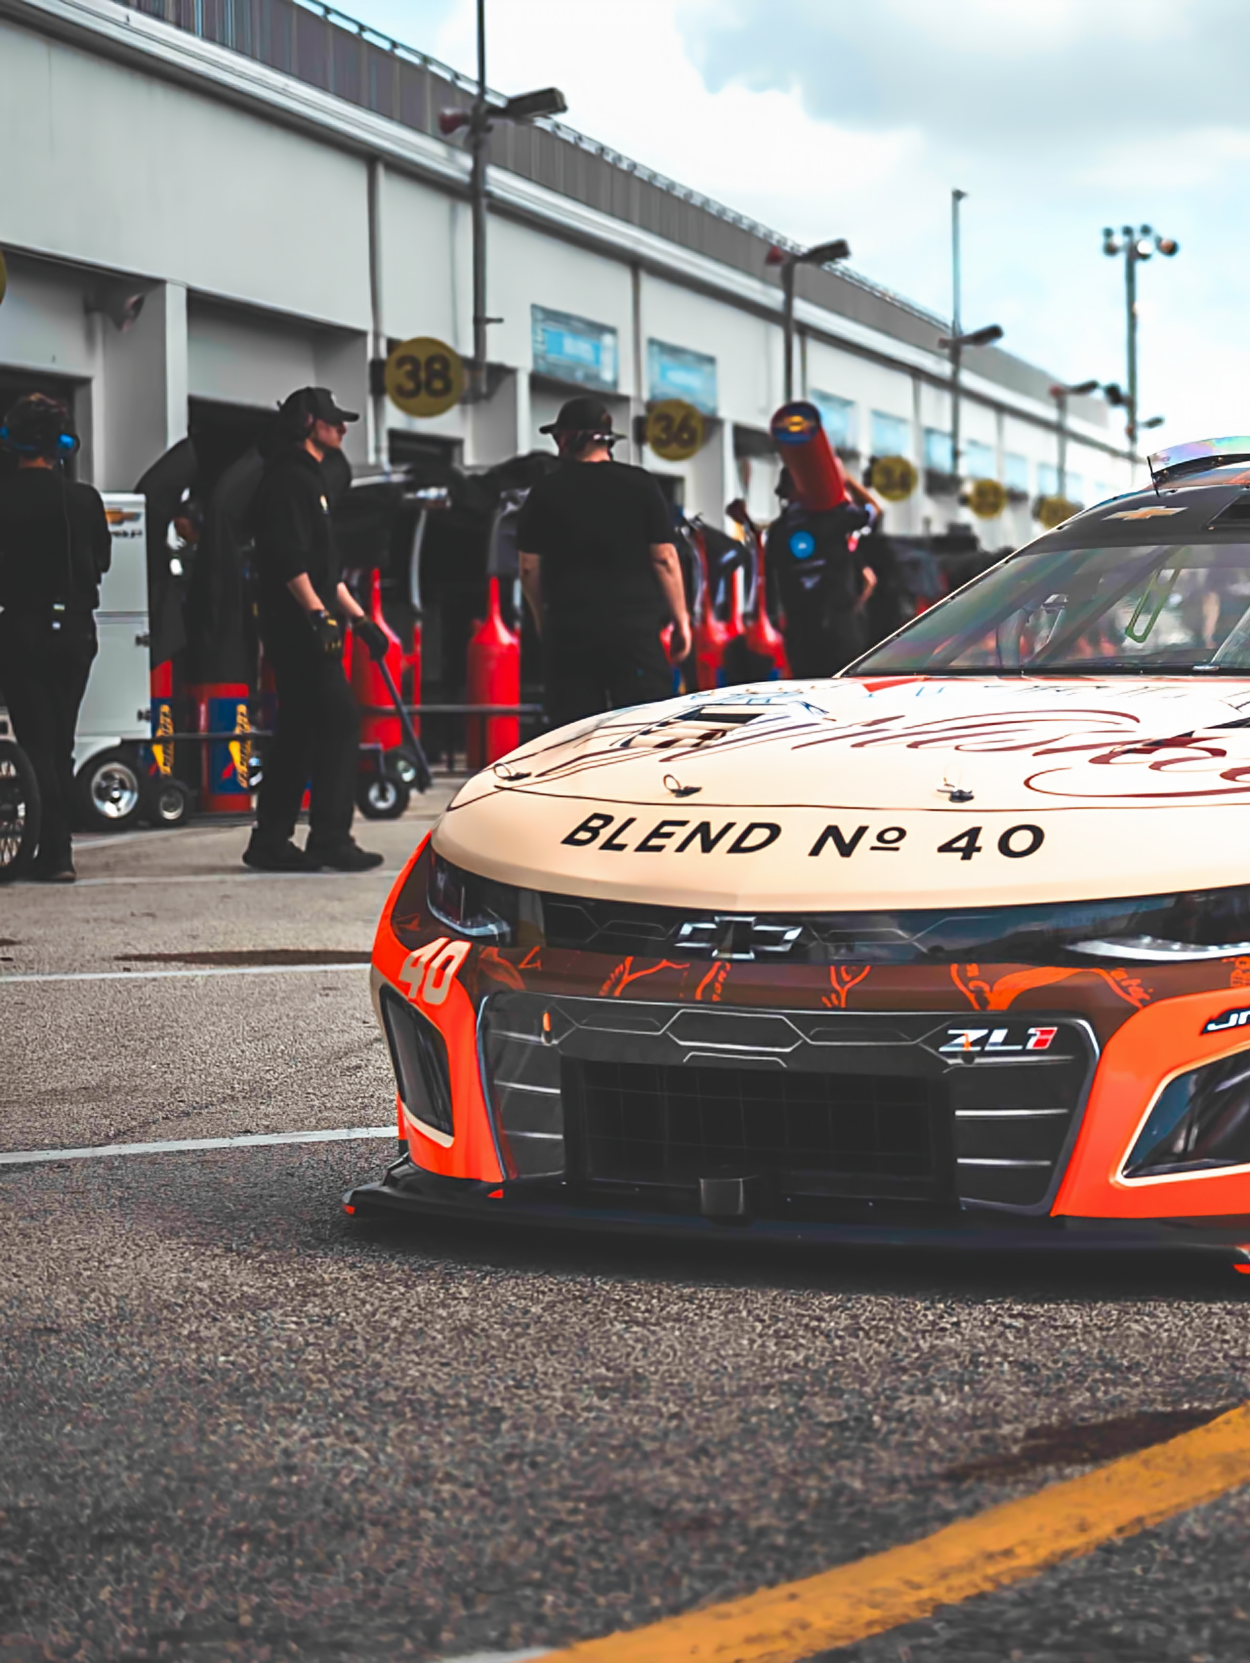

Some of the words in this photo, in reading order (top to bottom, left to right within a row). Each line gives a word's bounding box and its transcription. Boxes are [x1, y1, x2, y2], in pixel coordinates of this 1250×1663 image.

[394, 353, 453, 399] 38
[653, 411, 698, 449] 36
[560, 812, 782, 855] BLEND
[936, 824, 1046, 861] 40
[399, 937, 472, 1005] 40
